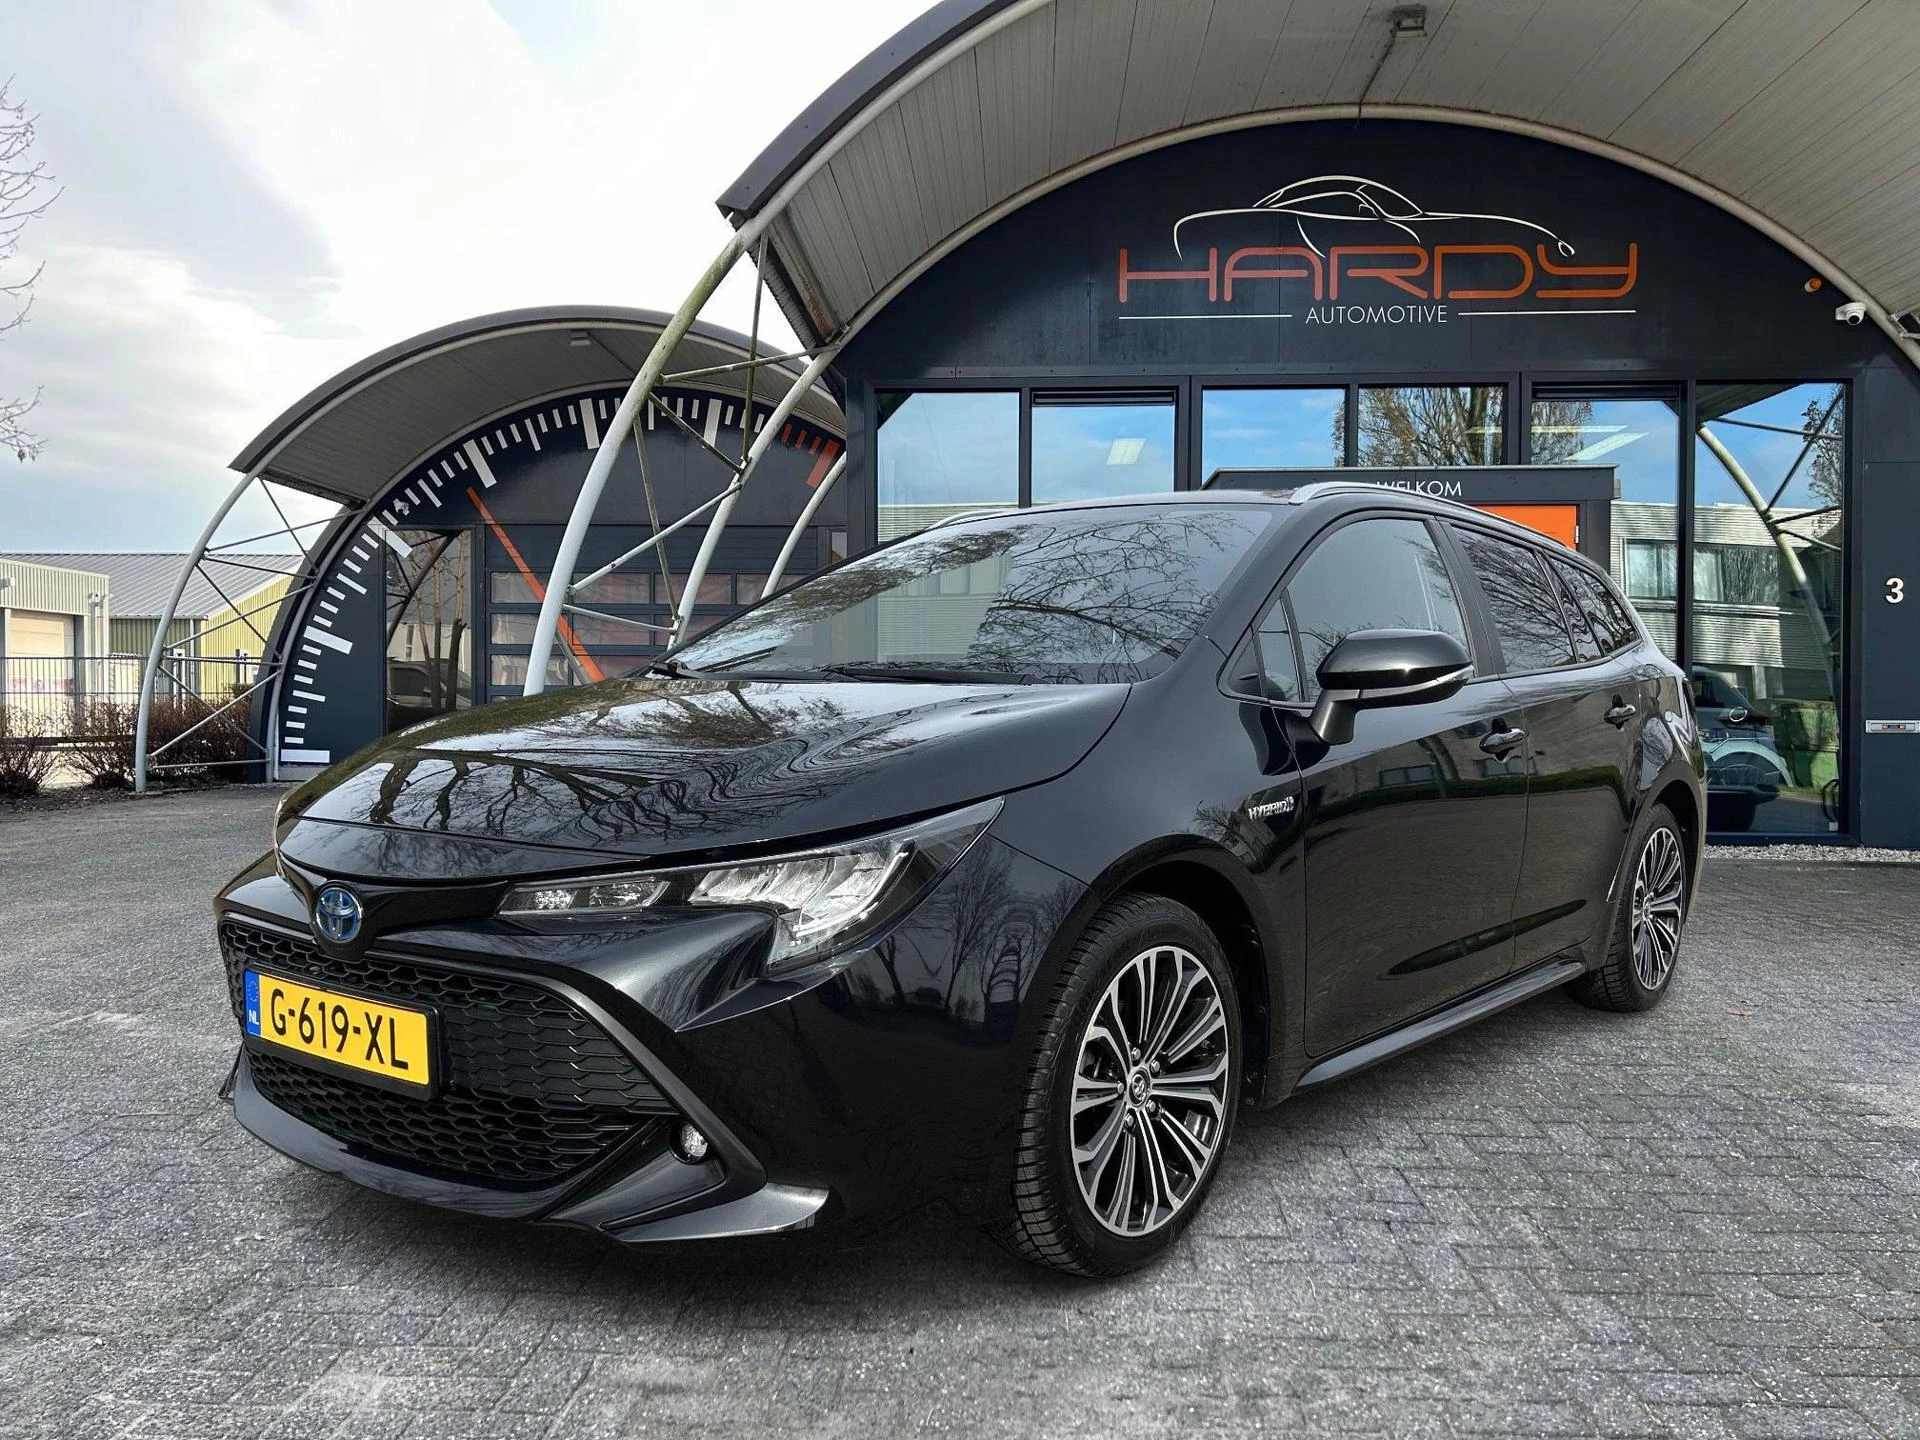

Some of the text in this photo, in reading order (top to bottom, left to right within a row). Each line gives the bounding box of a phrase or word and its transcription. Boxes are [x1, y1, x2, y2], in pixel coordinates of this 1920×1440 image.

[1119, 243, 1637, 302] HARDY
[1305, 305, 1448, 324] AUTOMOTIVE
[1885, 577, 1904, 604] 3
[248, 1009, 260, 1026] NL
[271, 988, 409, 1070] G-619-XL
